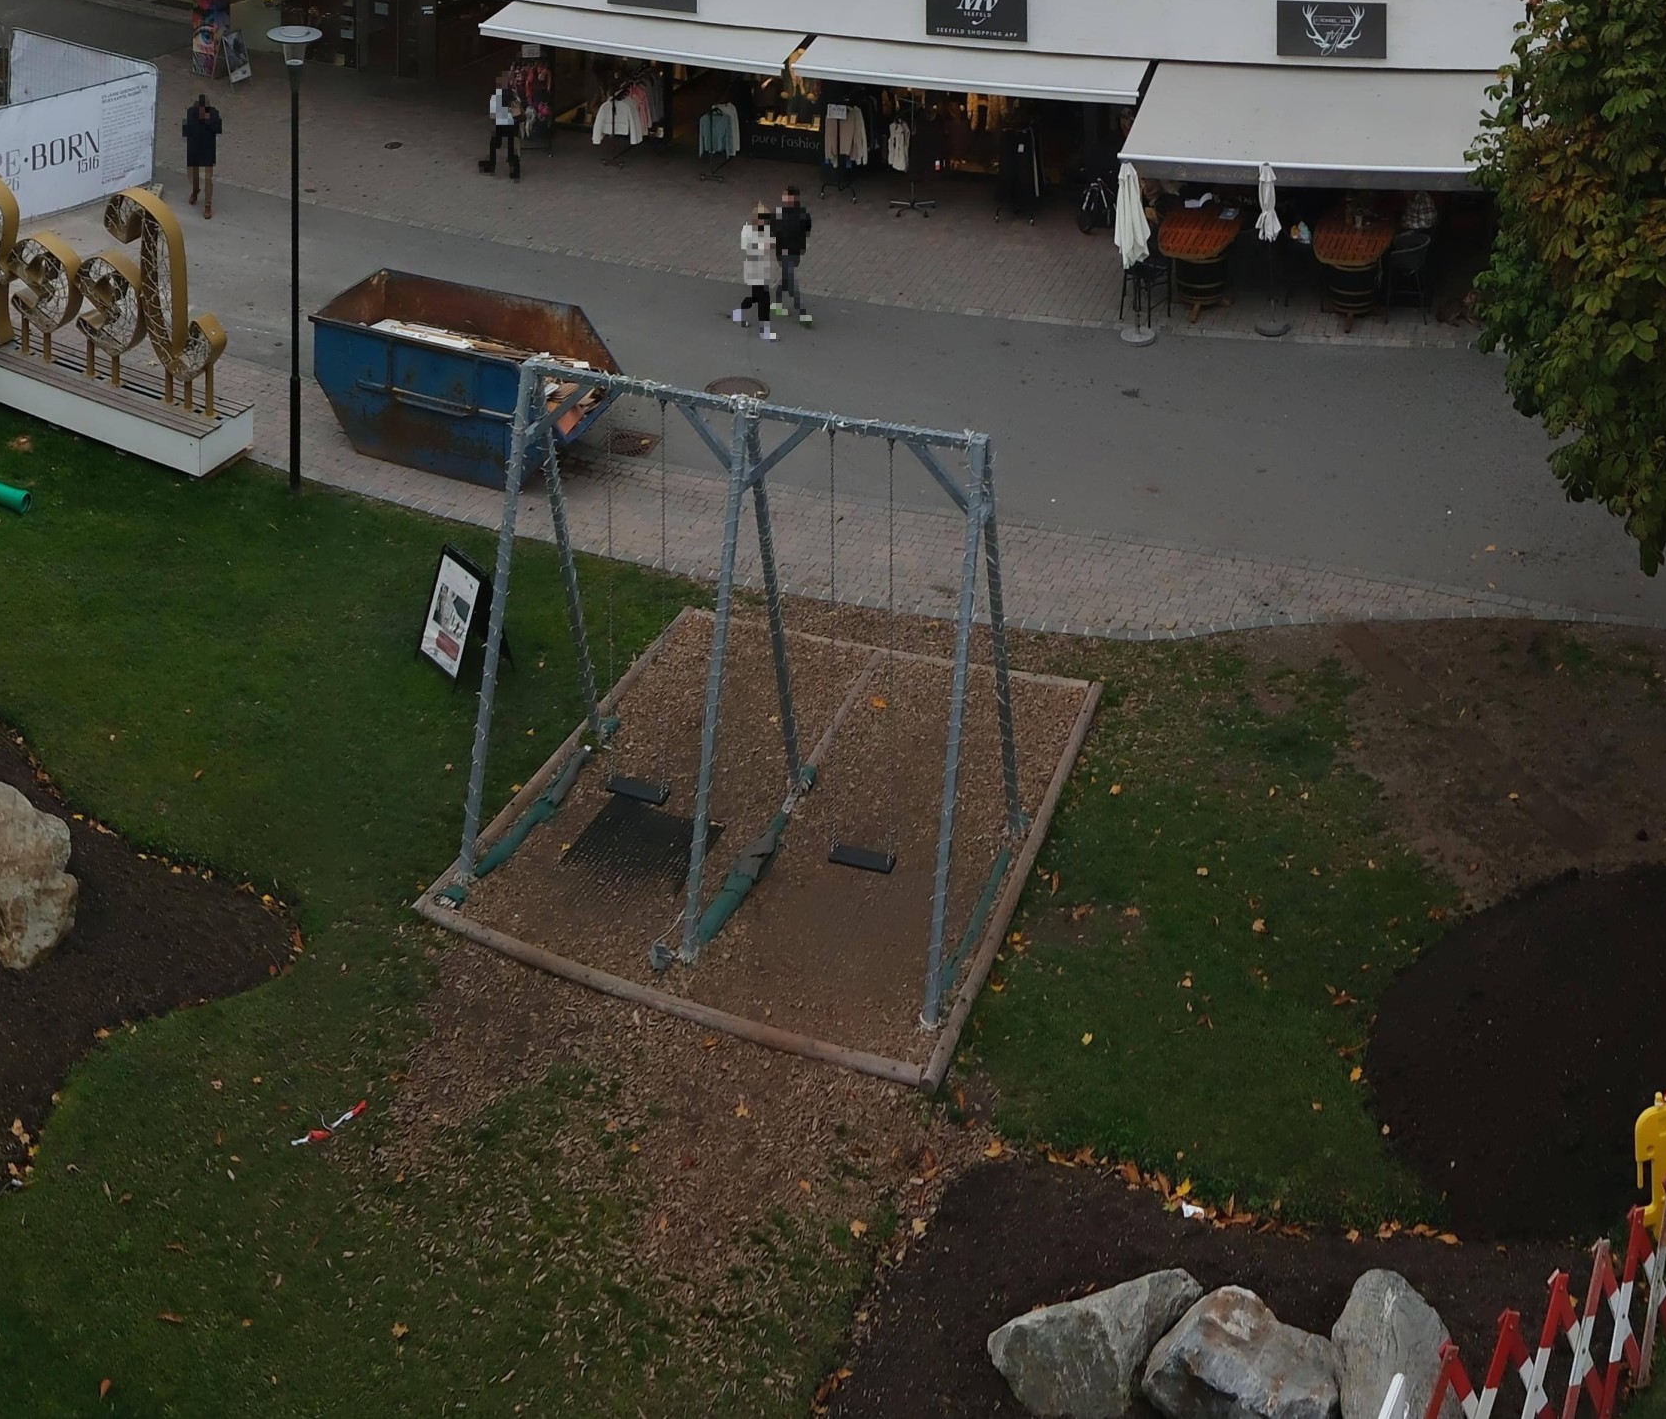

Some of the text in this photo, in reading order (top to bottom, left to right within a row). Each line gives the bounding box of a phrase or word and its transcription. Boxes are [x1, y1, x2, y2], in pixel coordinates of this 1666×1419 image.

[967, 29, 1002, 37] SHOPPING
[751, 133, 777, 146] pure
[77, 155, 99, 174] 1516
